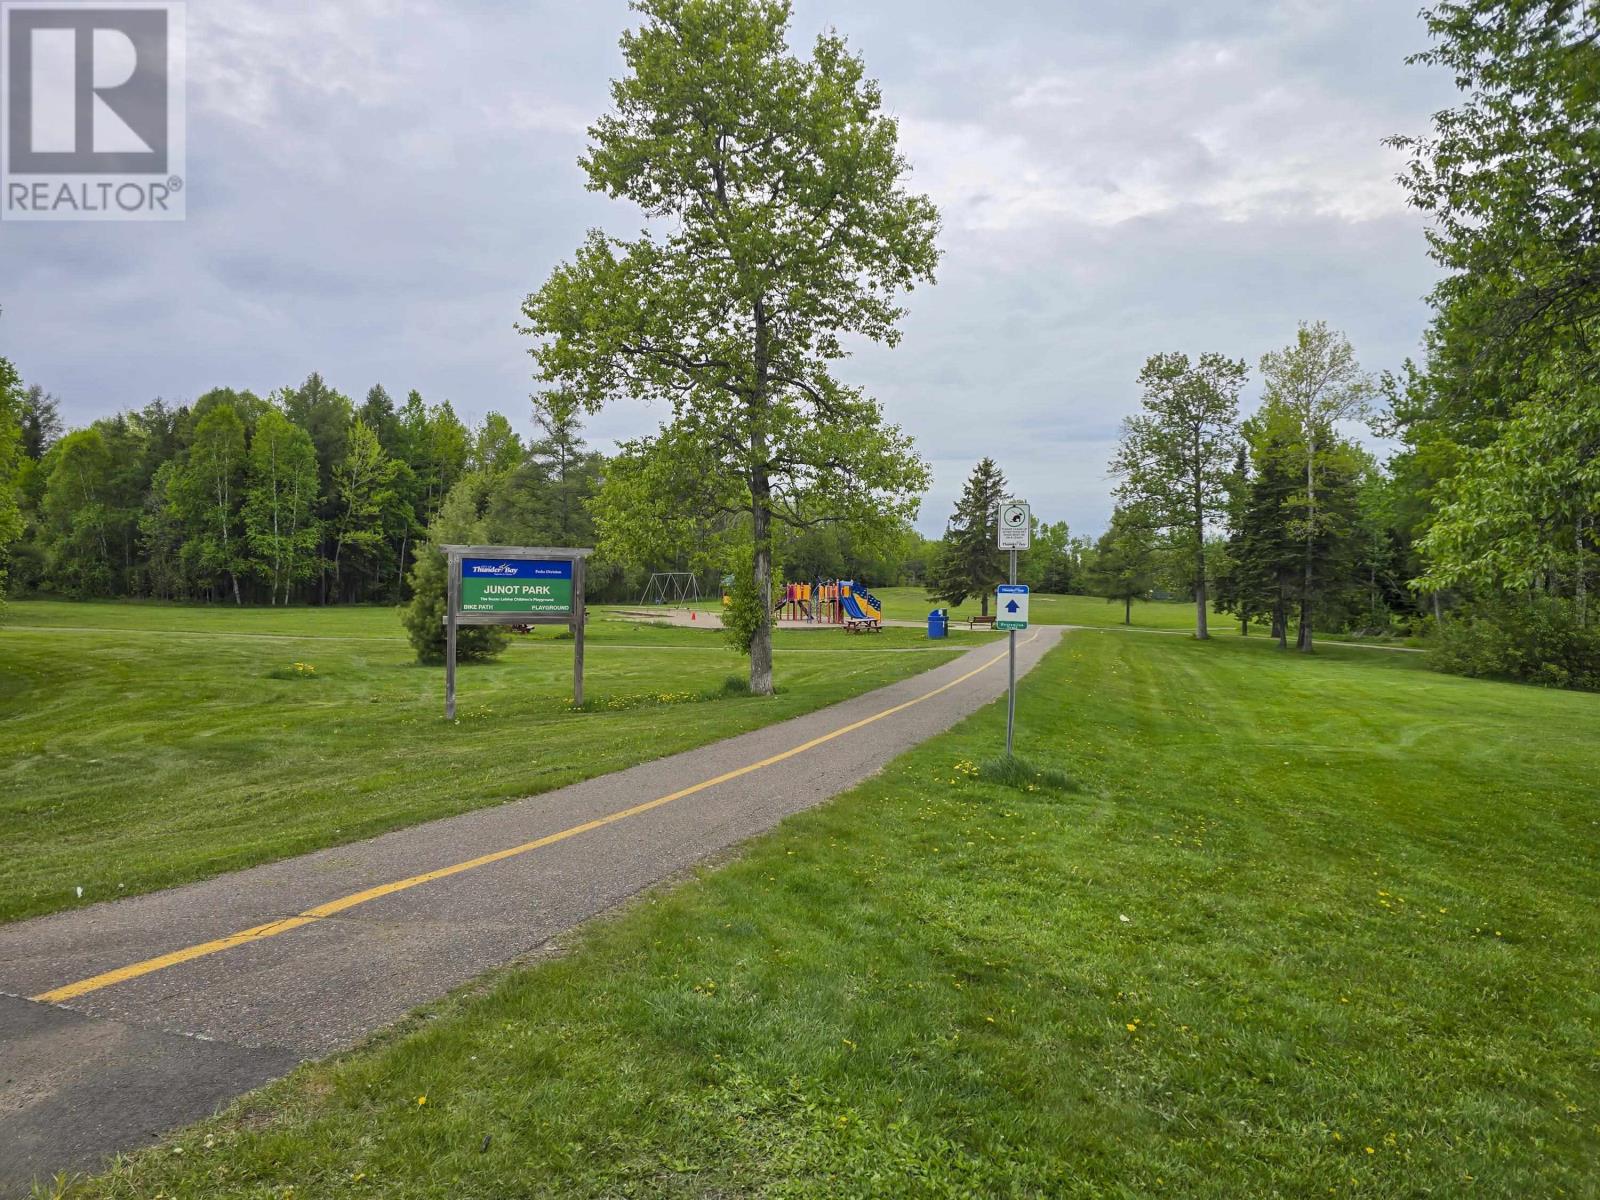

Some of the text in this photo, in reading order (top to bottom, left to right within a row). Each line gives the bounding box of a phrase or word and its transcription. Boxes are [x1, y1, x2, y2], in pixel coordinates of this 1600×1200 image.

[505, 567, 518, 575] Bay
[484, 586, 550, 594] JUNOT PARK
